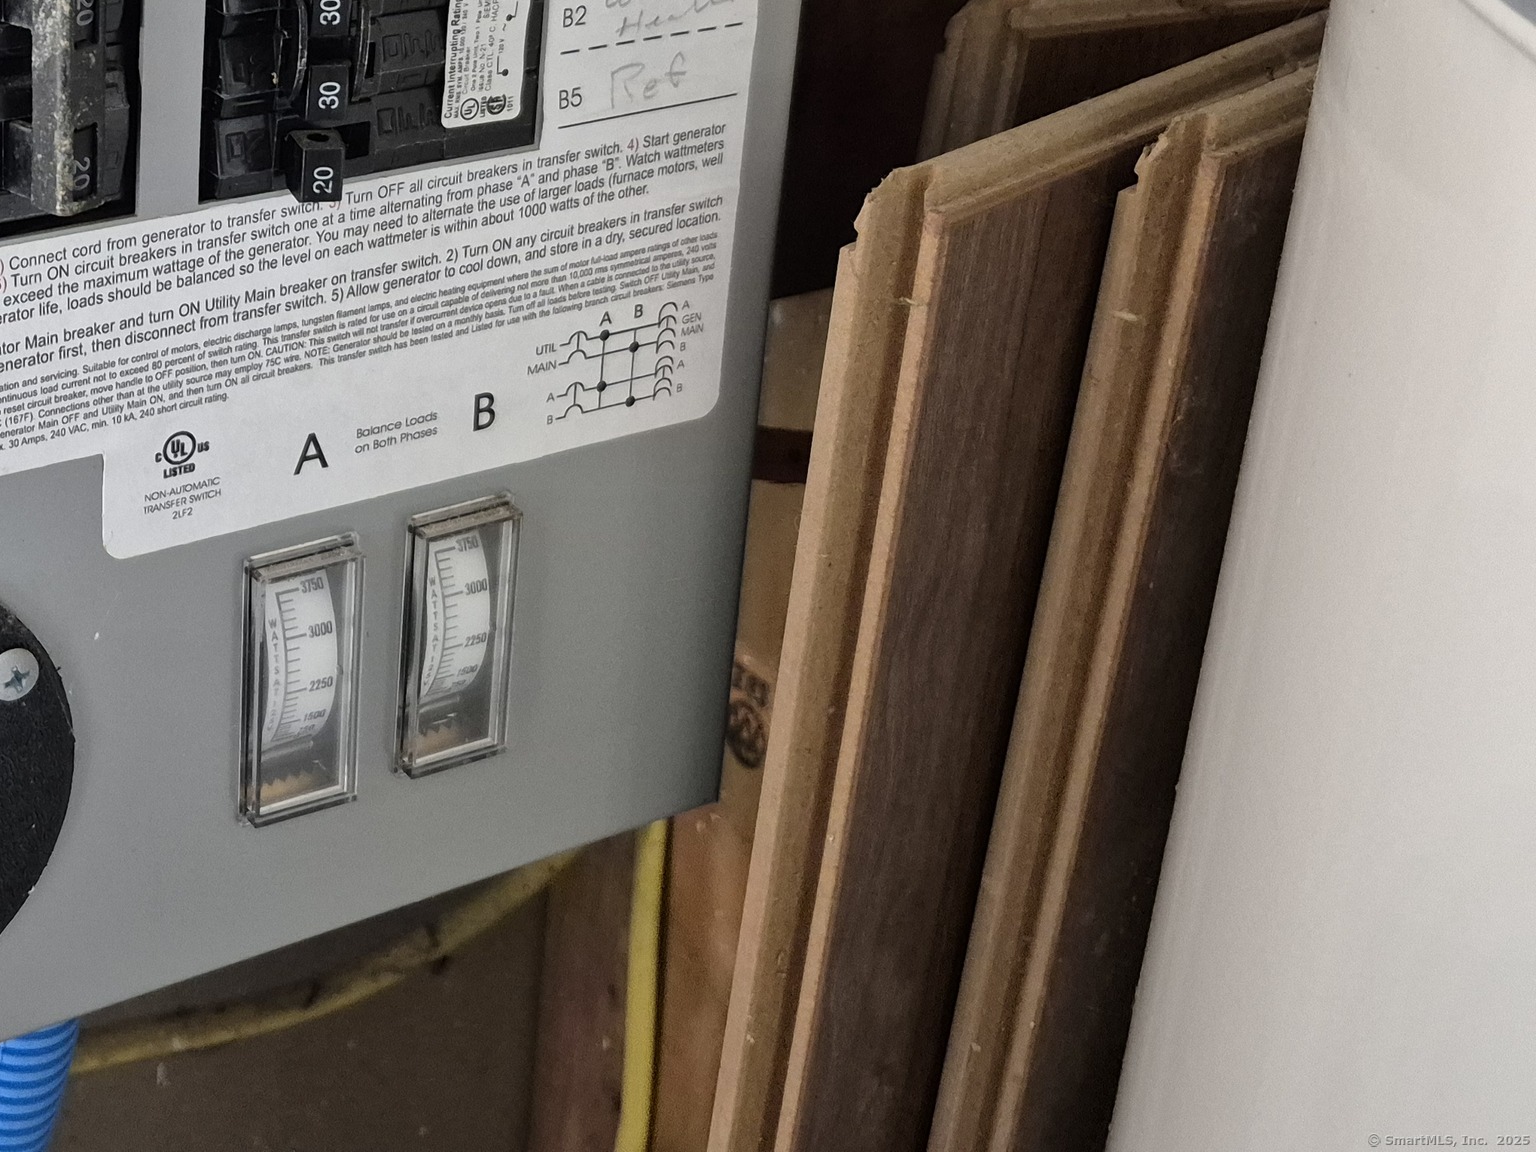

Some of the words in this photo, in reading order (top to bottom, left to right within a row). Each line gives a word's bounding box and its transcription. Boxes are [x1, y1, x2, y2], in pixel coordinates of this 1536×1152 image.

[562, 5, 587, 29] B2
[448, 29, 461, 83] Interrupting
[318, 81, 341, 110] 30
[444, 85, 455, 118] Current
[559, 86, 583, 110] B5
[72, 157, 91, 190] 20
[312, 166, 334, 194] 20
[9, 248, 66, 270] Connect
[72, 240, 101, 258] cord
[107, 237, 136, 251] from
[142, 223, 205, 248] generator
[211, 219, 222, 231] to
[228, 208, 276, 228] transfer
[345, 191, 372, 204] Turn
[378, 182, 405, 198] OFF
[410, 179, 422, 193] all
[428, 172, 462, 189] circuit
[467, 164, 518, 182] breakers
[523, 159, 532, 171] in
[537, 150, 581, 168] transfer
[585, 142, 622, 159] switch.
[627, 138, 639, 151] 4)
[643, 133, 669, 148] Start
[673, 124, 726, 145] generator
[599, 311, 613, 327] A
[634, 304, 644, 319] B
[682, 312, 702, 324] GEN
[680, 323, 704, 337] MAIN
[535, 342, 557, 356] UTIL
[527, 359, 557, 375] MAIN
[472, 392, 496, 432] B
[356, 419, 403, 439] Balance
[405, 411, 438, 428] Loads
[197, 441, 210, 453] US
[354, 442, 370, 454] on
[373, 435, 397, 450] Both
[400, 425, 438, 443] Phases
[293, 432, 329, 476] A
[163, 463, 196, 479] LISTED
[144, 476, 221, 502] NON-AUTOMATIC
[144, 497, 187, 515] TRANSFER
[189, 489, 222, 504] SWITCH
[172, 507, 193, 520] 2LF2
[455, 535, 479, 552] 3750
[300, 577, 324, 594] 3750
[464, 578, 488, 596] 3000
[308, 620, 333, 639] 3000
[464, 632, 487, 648] 2250
[308, 676, 334, 693] 2250
